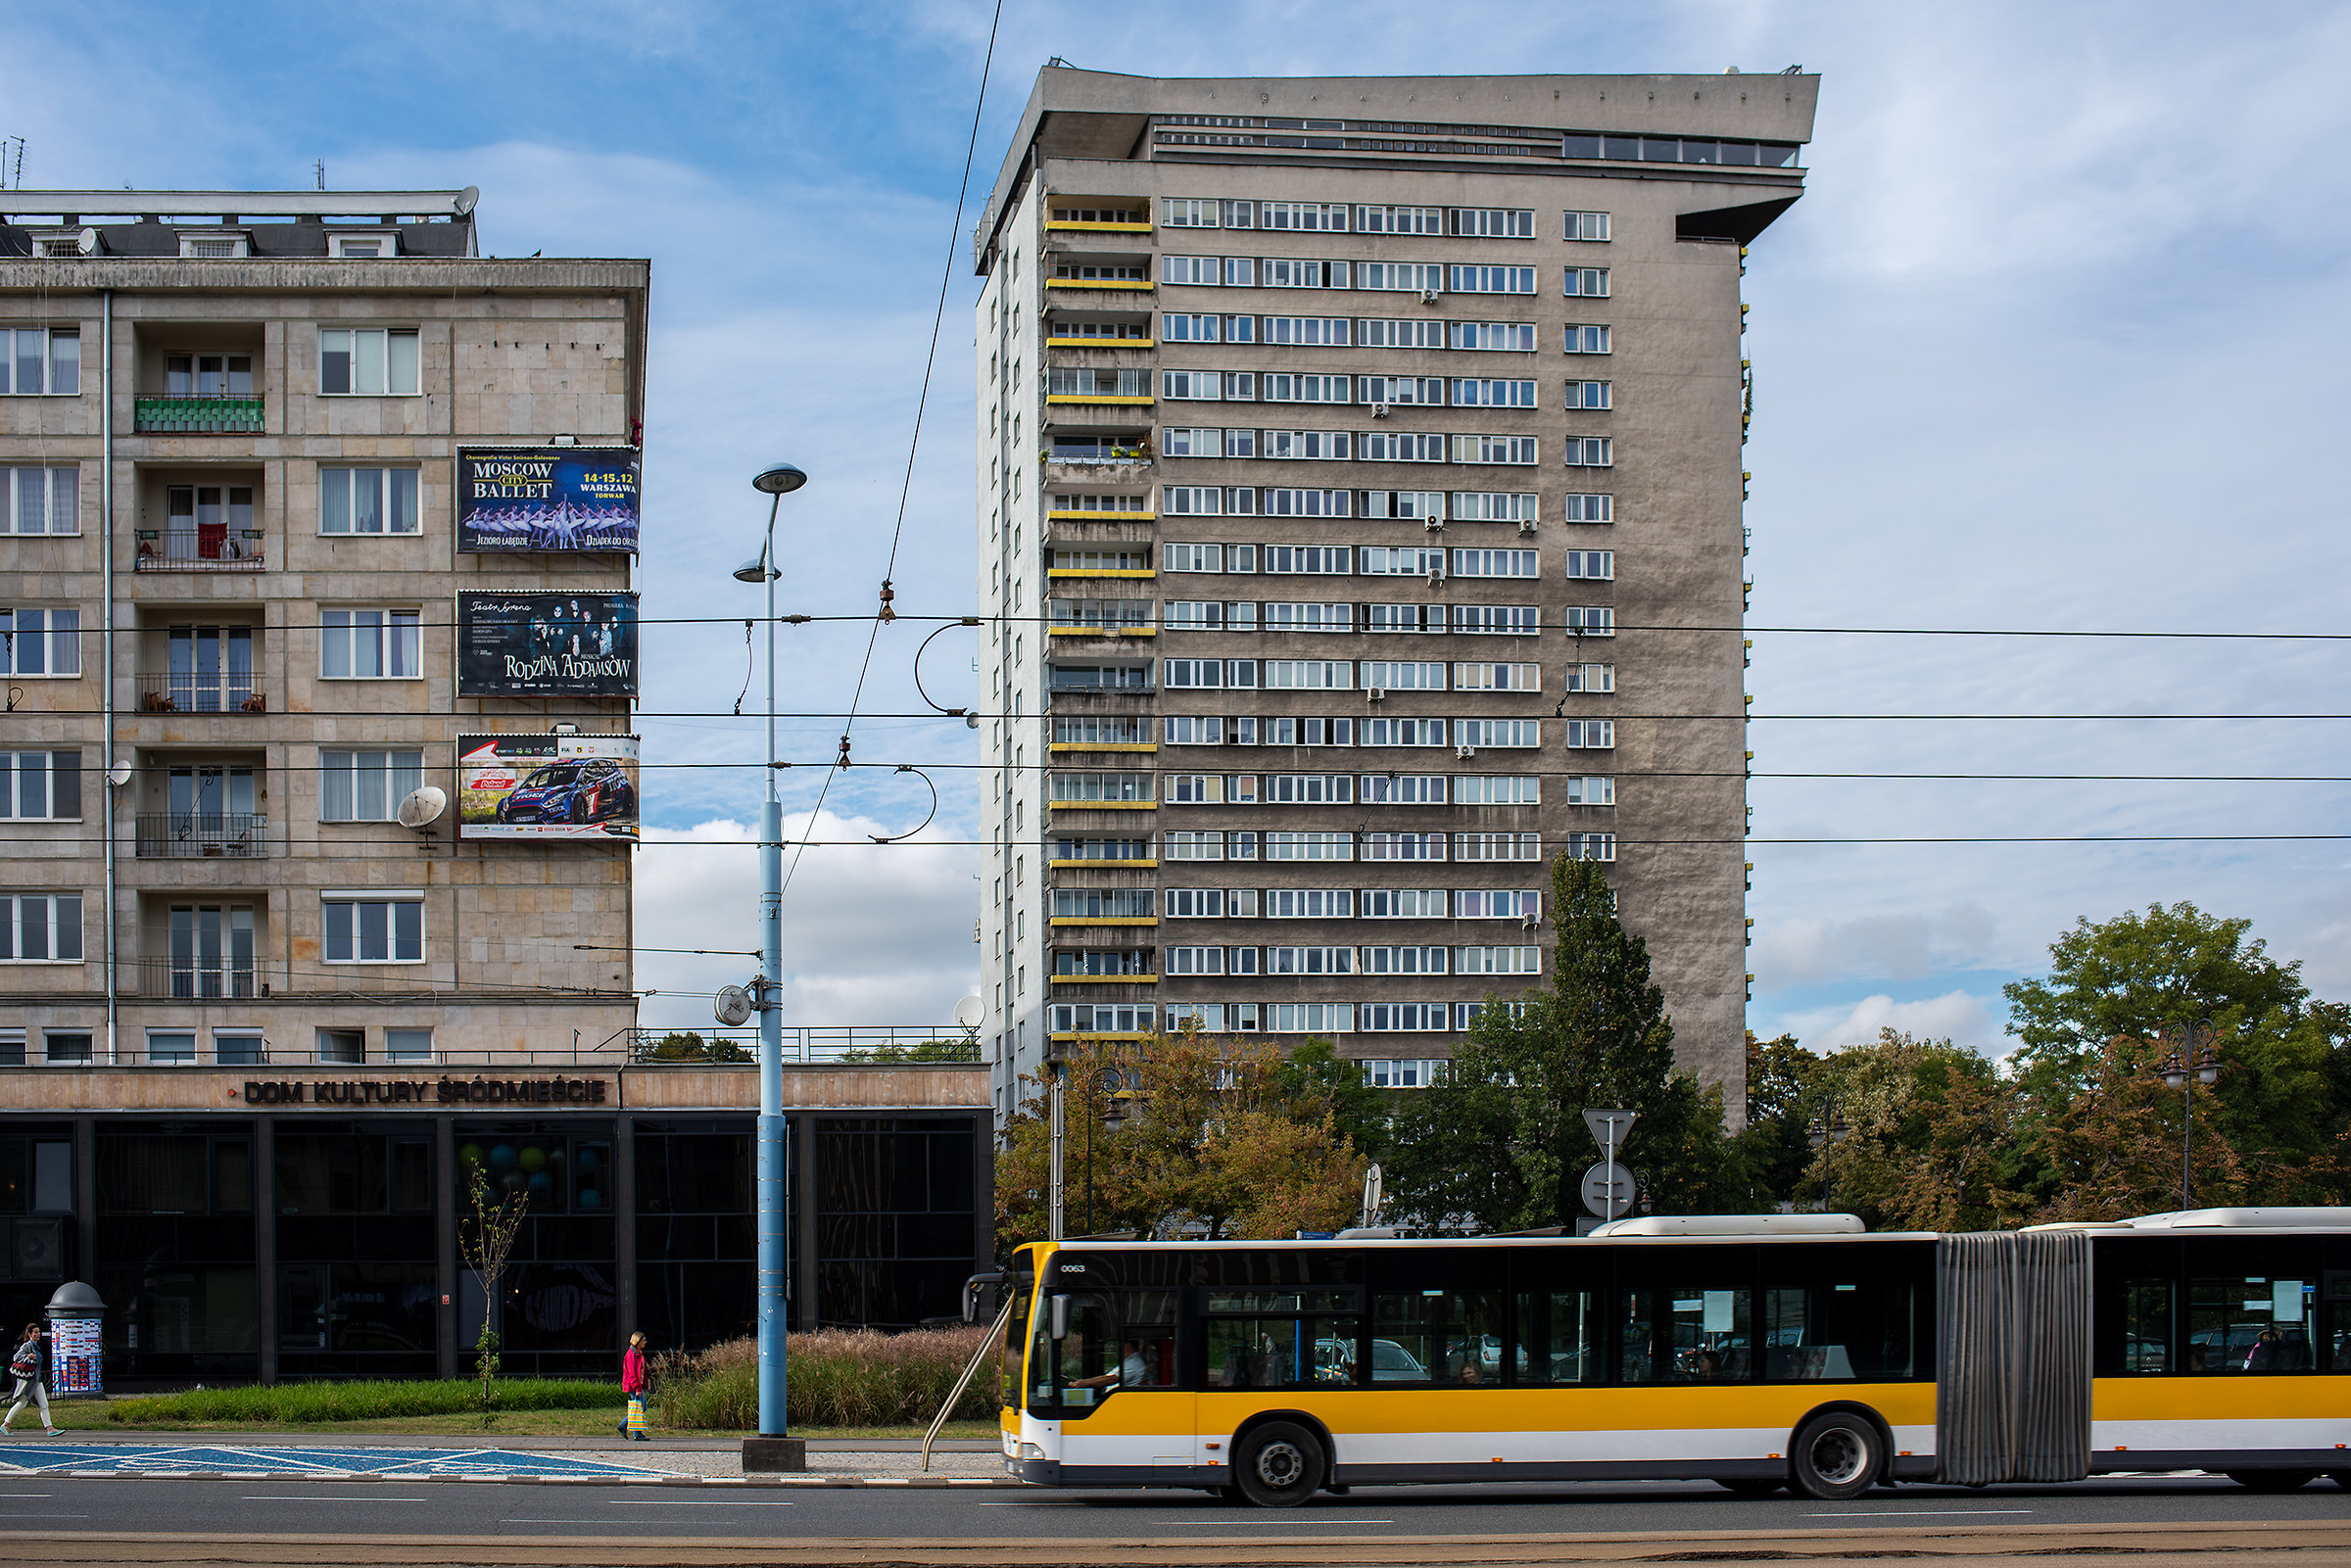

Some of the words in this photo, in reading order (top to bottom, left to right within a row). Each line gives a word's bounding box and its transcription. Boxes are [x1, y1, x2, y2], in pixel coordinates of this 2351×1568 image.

[473, 462, 553, 478] MOSCOW
[502, 476, 524, 485] CITY
[584, 473, 633, 484] 14-15.12
[473, 483, 552, 499] BALLET
[580, 484, 637, 494] WARSZAWA
[476, 534, 501, 546] JEZIORO
[612, 537, 622, 546] DO
[470, 600, 499, 612] Teatr
[560, 653, 632, 679] ADDAMSÓW
[244, 1081, 304, 1103] DOM
[313, 1081, 428, 1103] KULTURY
[436, 1073, 605, 1103] ŚRÓDMIEŚCIE
